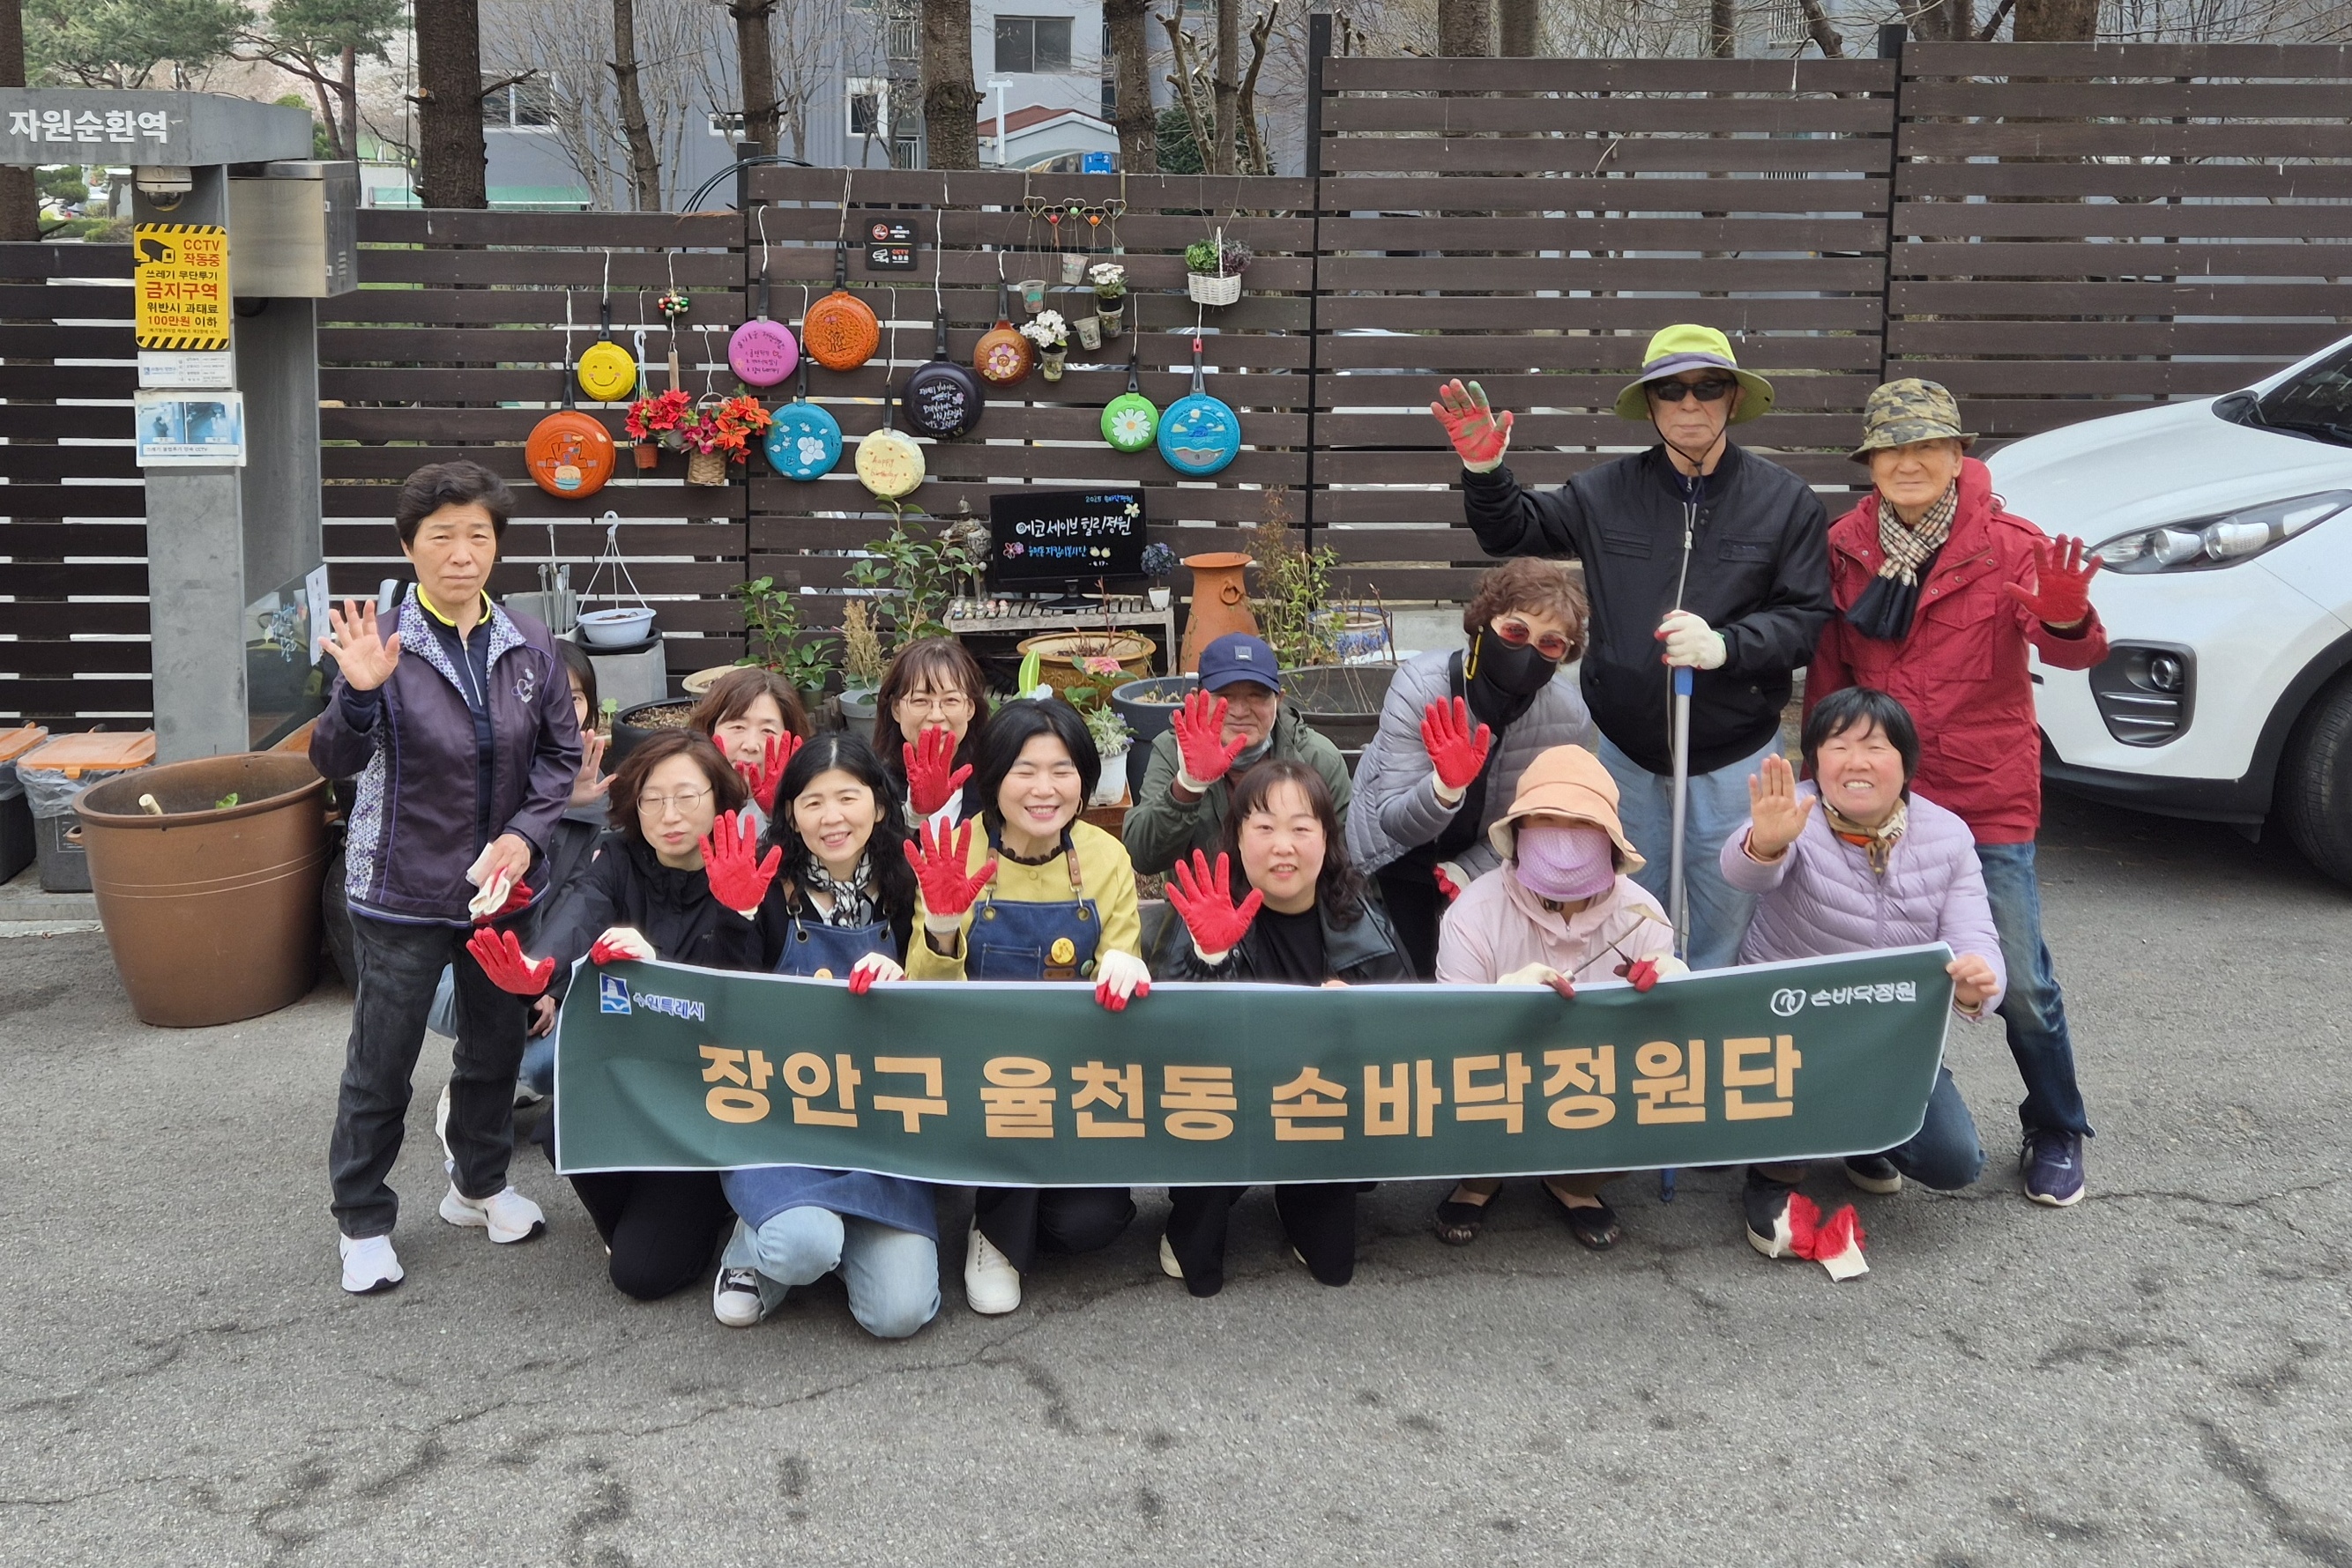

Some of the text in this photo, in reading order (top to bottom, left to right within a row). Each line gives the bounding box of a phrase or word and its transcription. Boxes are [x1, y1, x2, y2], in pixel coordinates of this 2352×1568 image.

[9, 108, 167, 144] 자원순환역
[183, 239, 220, 251] CCTV
[183, 252, 220, 267] 작동중
[145, 270, 218, 280] 쓰레기 무단투기
[145, 281, 218, 301] 금지구역
[147, 302, 219, 314] 위반시 과태료
[147, 316, 217, 327] 100만원 이하
[872, 455, 894, 468] happy
[871, 468, 898, 484] birthday
[1810, 980, 1917, 1007] 손바닥정원
[633, 992, 705, 1022] 수원특례시
[698, 1035, 1802, 1141] 장안구 율천동 손바닥정원단
